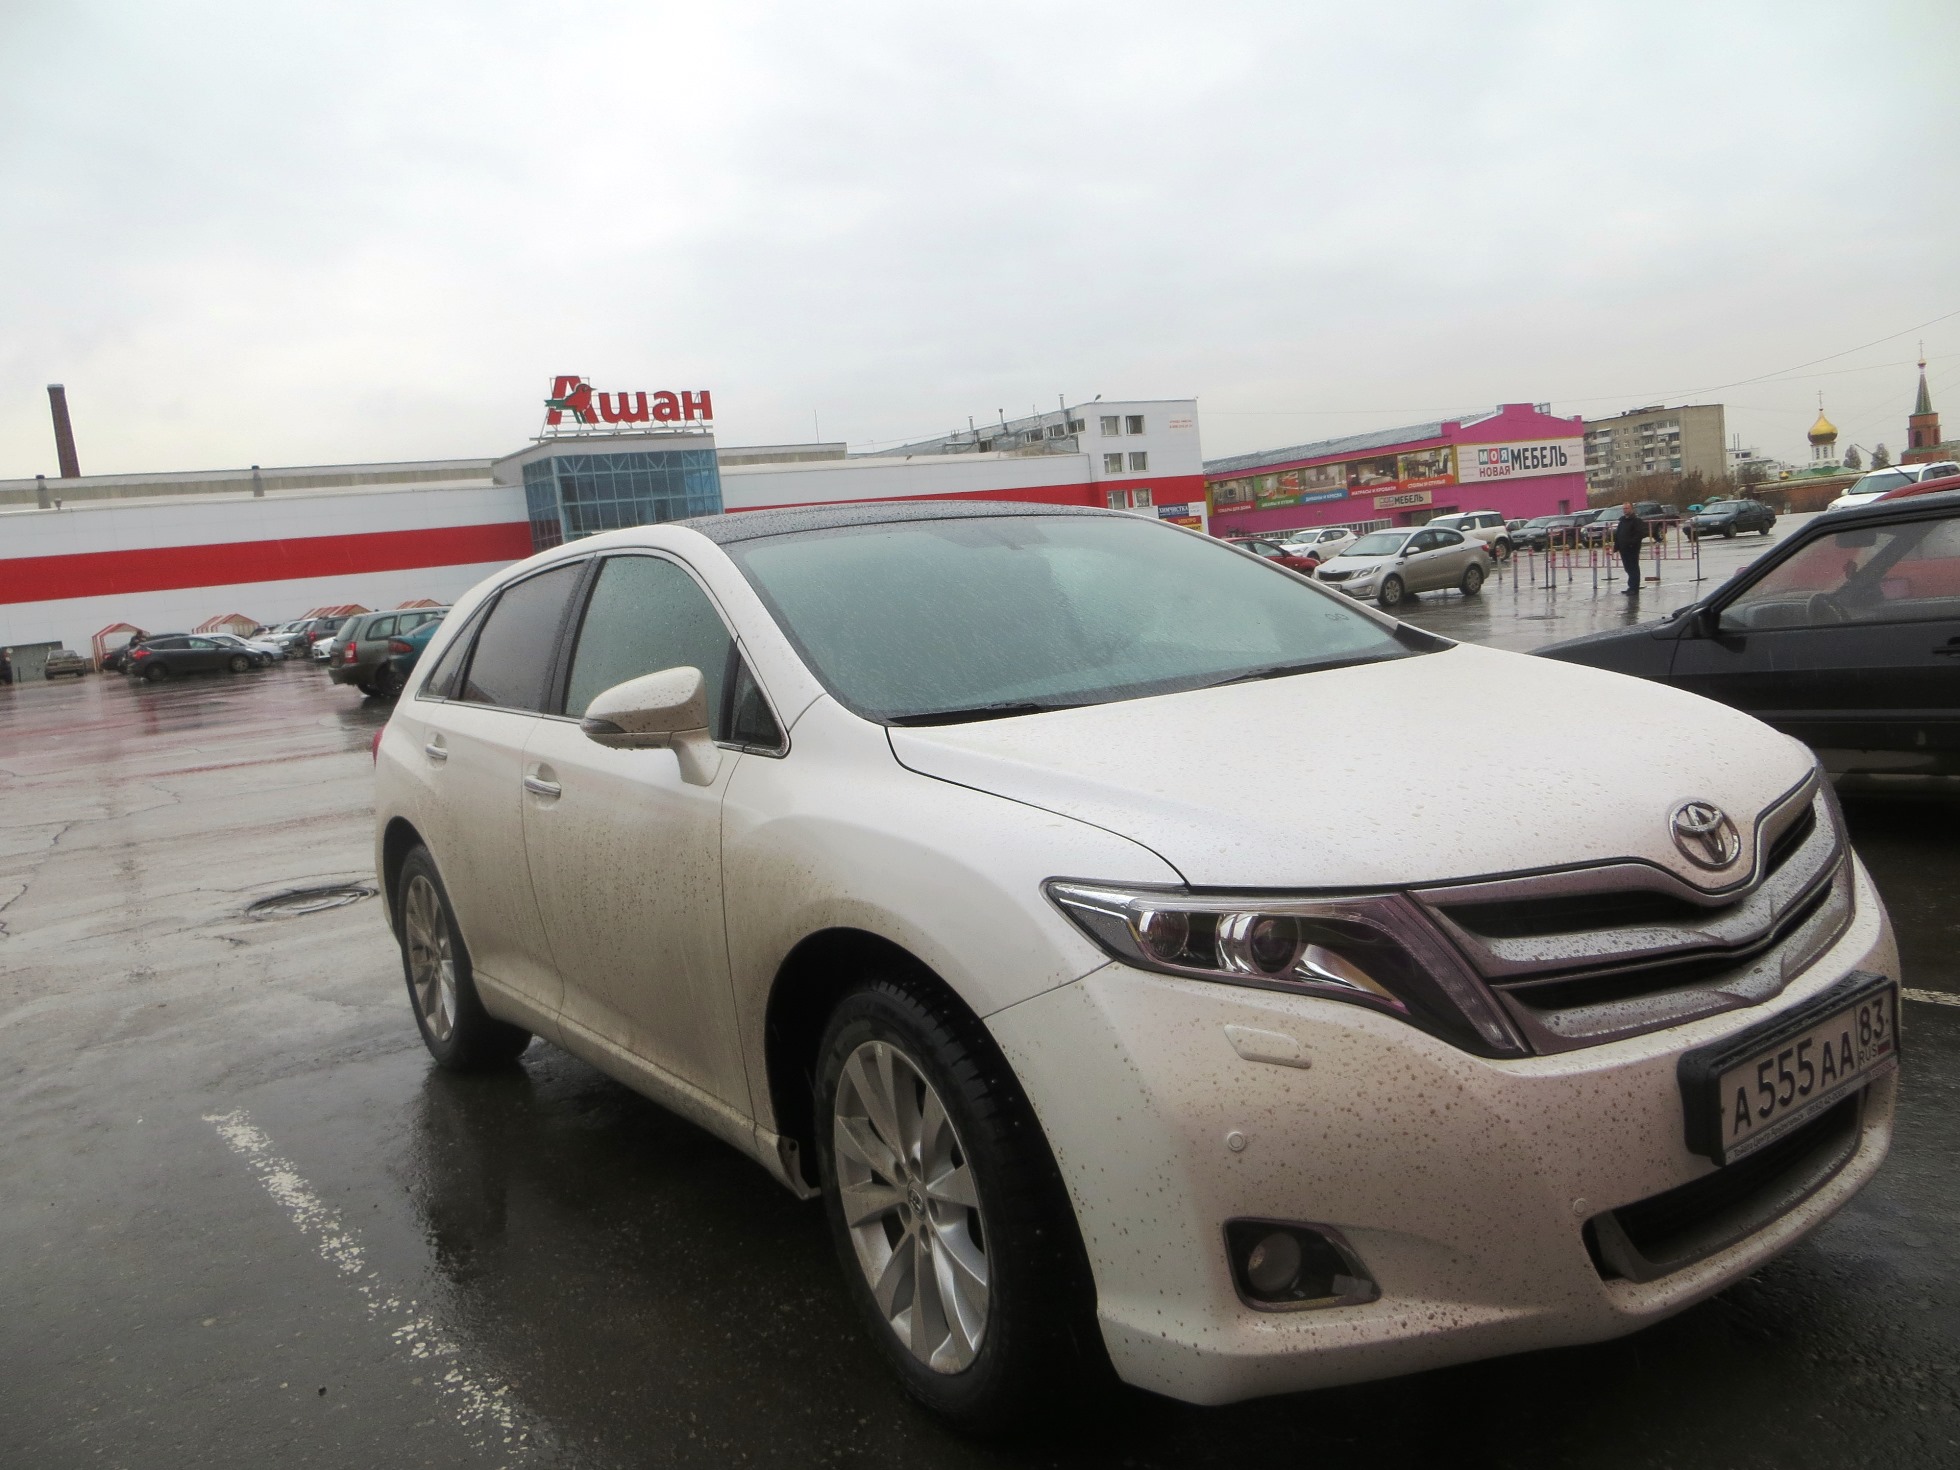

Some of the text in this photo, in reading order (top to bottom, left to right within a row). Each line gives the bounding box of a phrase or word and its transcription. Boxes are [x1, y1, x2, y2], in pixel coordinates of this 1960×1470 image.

[546, 376, 713, 425] Ашан
[1478, 448, 1509, 465] МОЯ
[1511, 446, 1567, 471] МЕБЕЛЬ
[1480, 466, 1510, 477] НОВАЯ
[1394, 493, 1424, 505] МЕБЕЛЬ
[1859, 998, 1884, 1046] 83
[1858, 1044, 1877, 1064] RUS
